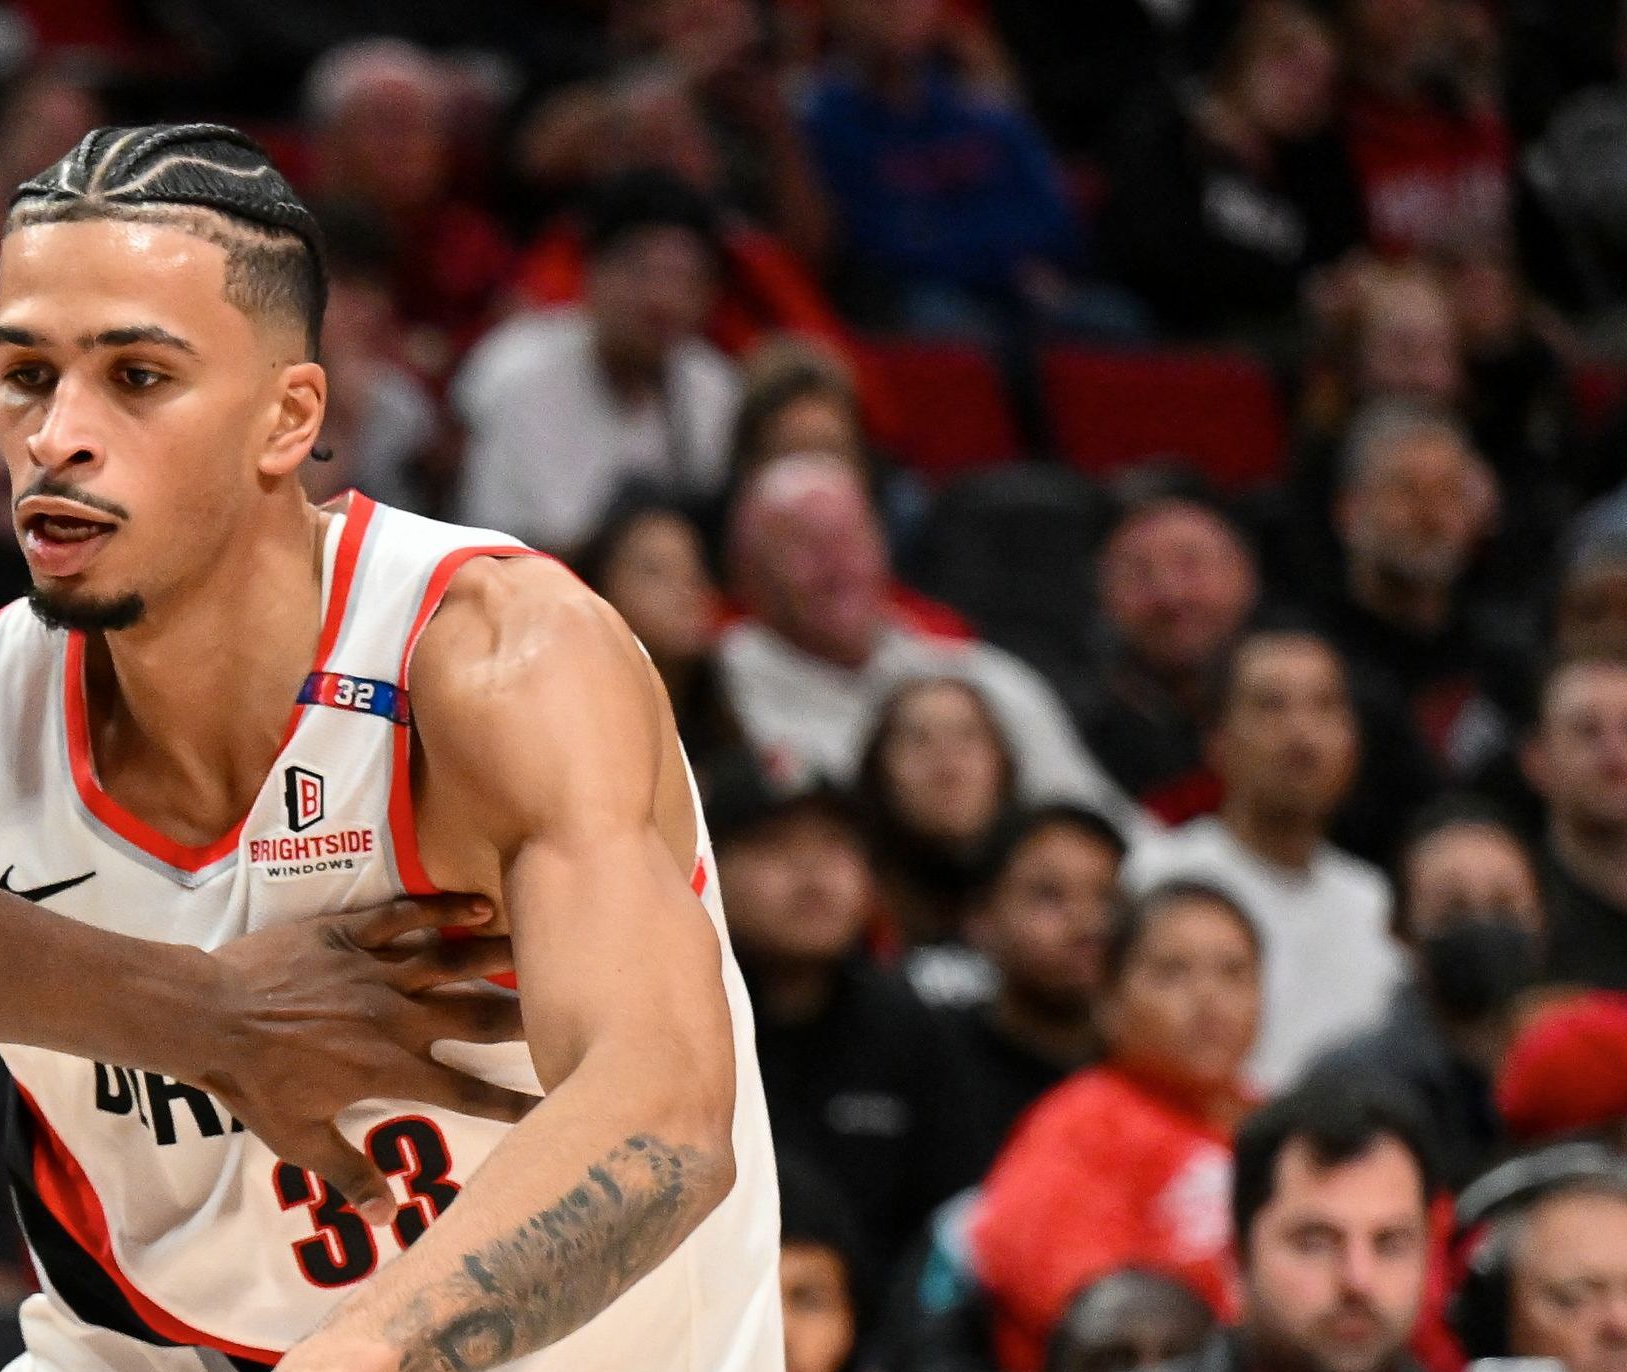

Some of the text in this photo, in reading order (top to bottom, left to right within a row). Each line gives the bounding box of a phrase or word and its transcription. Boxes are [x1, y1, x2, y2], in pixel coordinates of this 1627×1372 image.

[334, 679, 375, 710] 32
[301, 779, 318, 818] B
[249, 829, 373, 863] BRIGHTSIDE
[267, 858, 354, 877] WINDOWS
